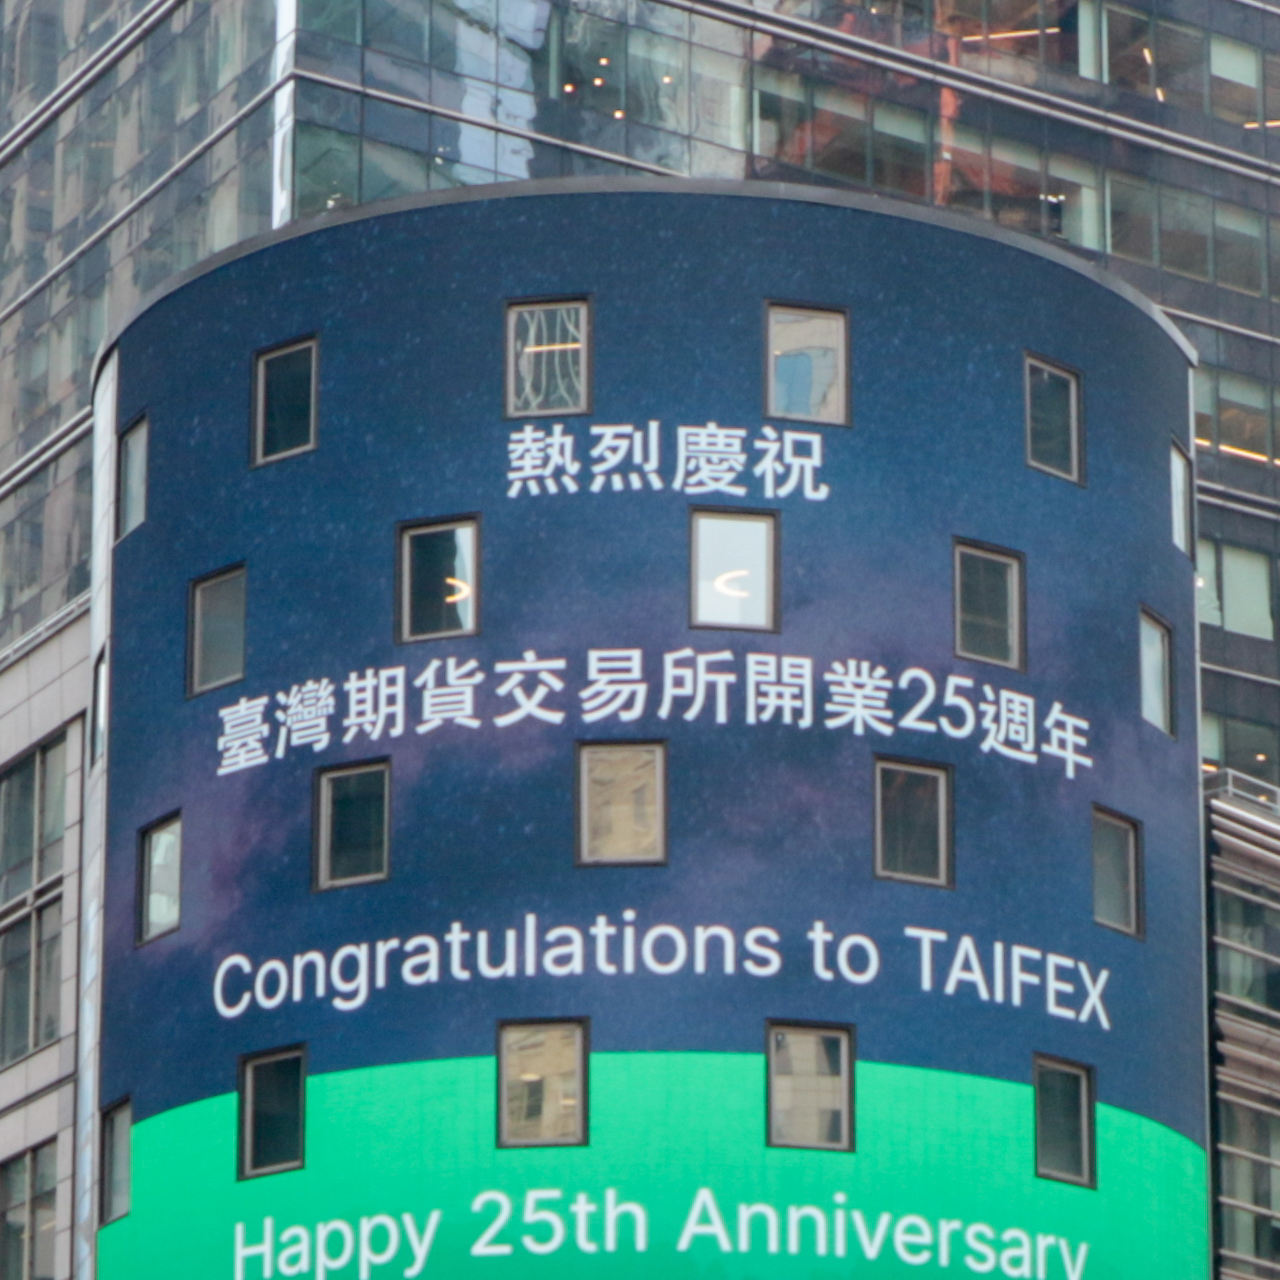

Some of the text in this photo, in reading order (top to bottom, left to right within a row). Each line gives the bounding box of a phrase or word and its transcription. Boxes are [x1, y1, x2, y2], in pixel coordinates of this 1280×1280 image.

[506, 421, 829, 499] 熱烈慶祝
[216, 648, 1093, 778] 臺灣期貨交易所開業25週年
[213, 909, 1110, 1030] Congratulations to TAIFEX
[470, 1187, 648, 1256] 25th
